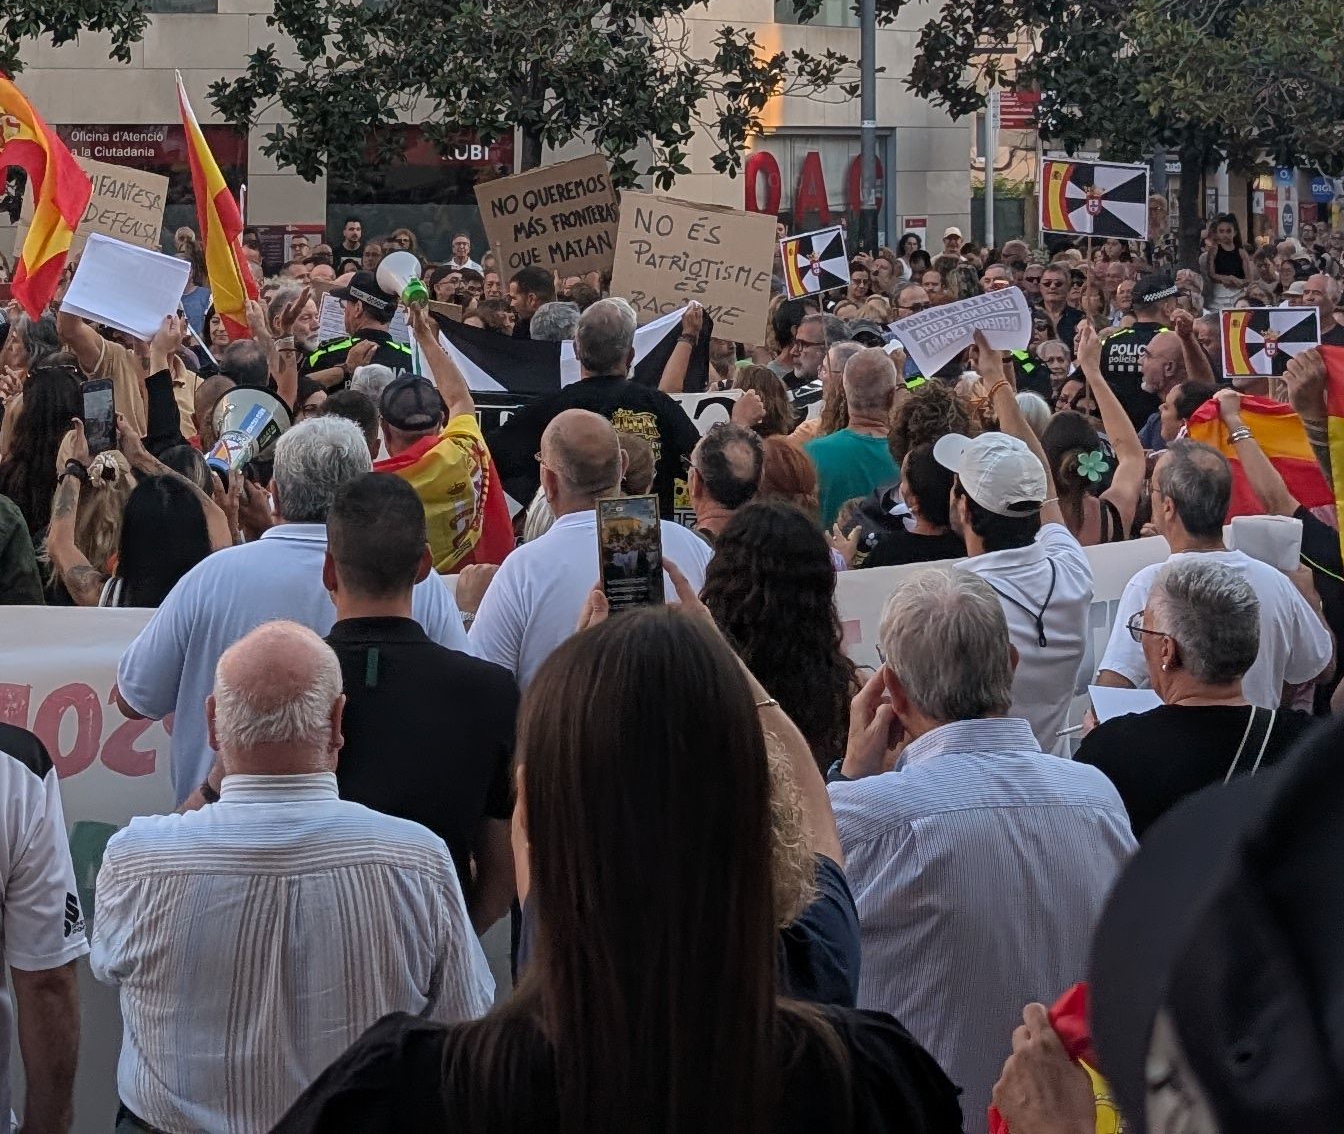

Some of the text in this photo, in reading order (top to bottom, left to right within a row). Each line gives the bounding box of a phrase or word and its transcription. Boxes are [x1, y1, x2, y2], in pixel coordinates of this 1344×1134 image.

[71, 130, 164, 142] Oficina d'Atenció
[442, 139, 496, 161] UBÍ
[81, 146, 91, 157] la
[94, 146, 155, 157] Ciutadania
[491, 173, 607, 218] NO QUEREMOS
[81, 203, 158, 243] DEFENSA
[513, 201, 620, 243] MÁS FRONTERAS
[634, 207, 722, 245] NO ÉS
[508, 230, 614, 268] QUE MATAN
[674, 277, 709, 294] ÉS
[1109, 344, 1147, 356] POLIC
